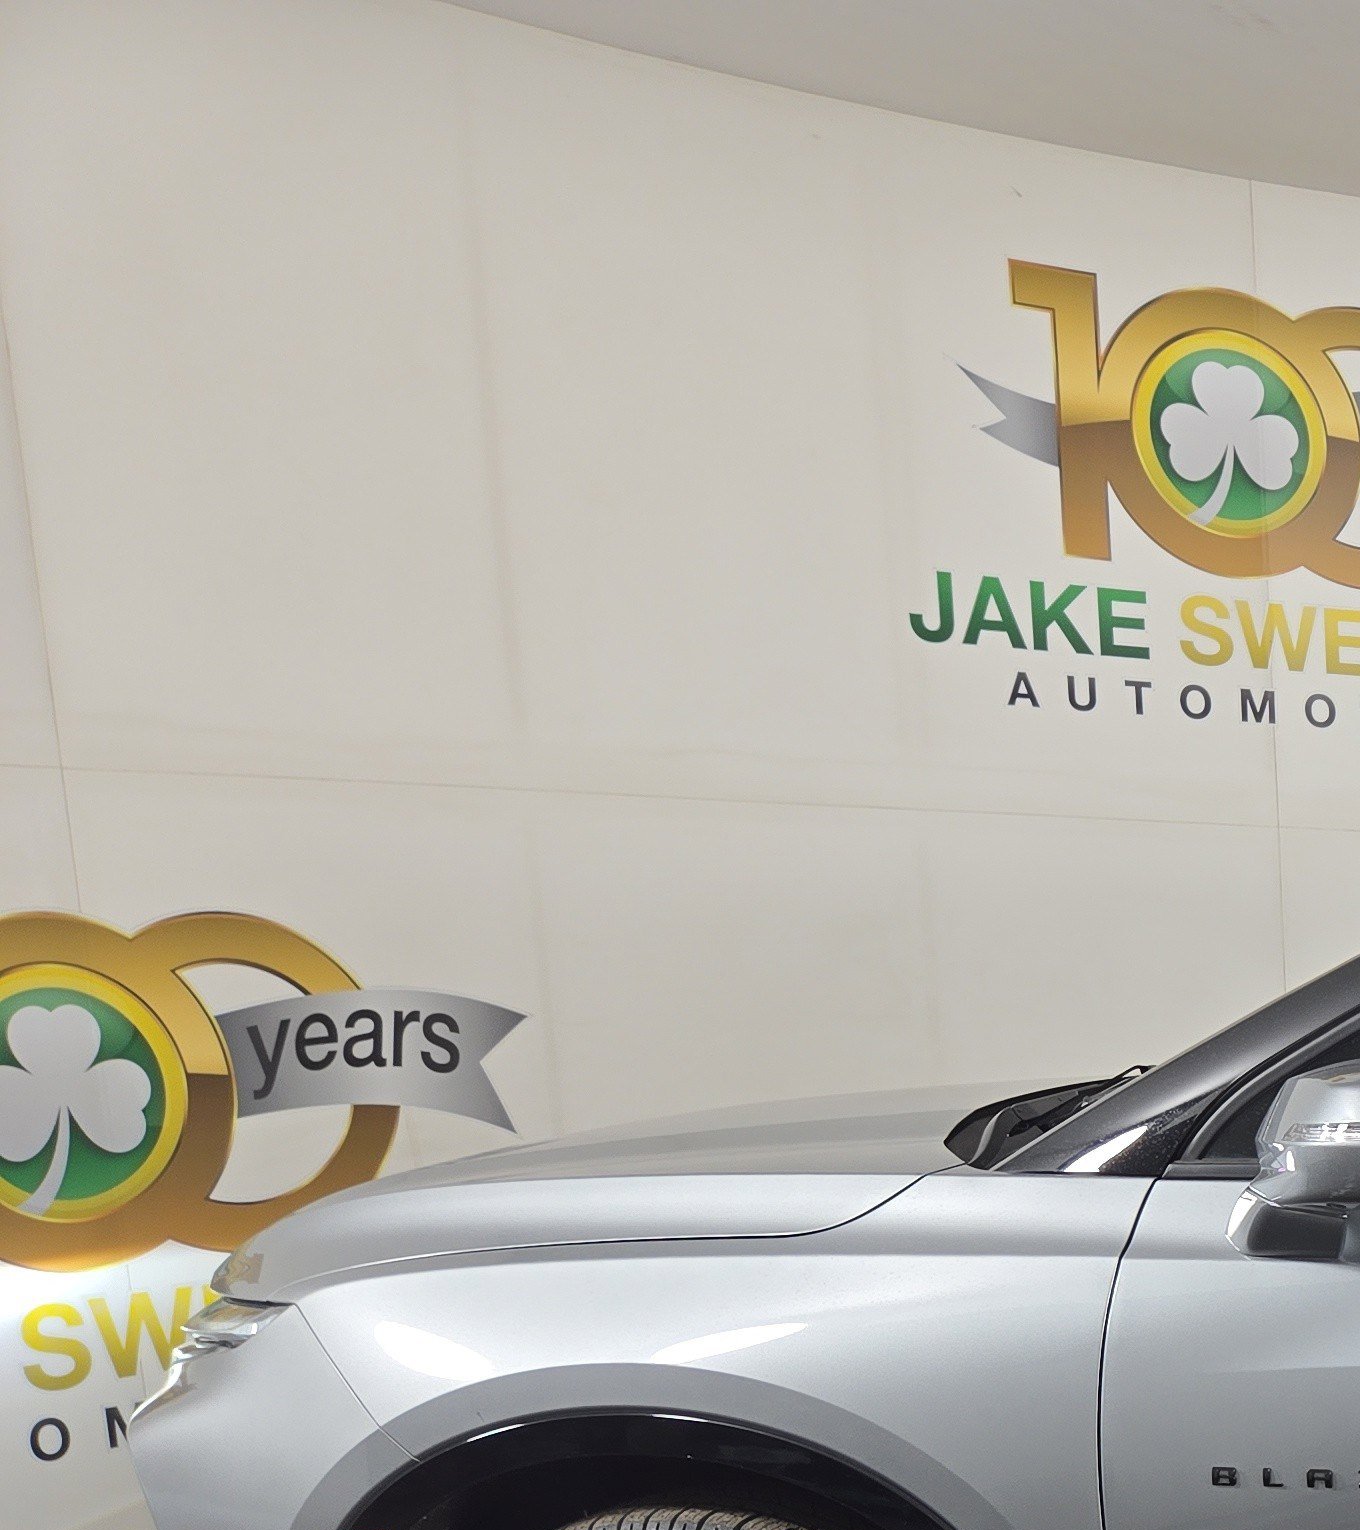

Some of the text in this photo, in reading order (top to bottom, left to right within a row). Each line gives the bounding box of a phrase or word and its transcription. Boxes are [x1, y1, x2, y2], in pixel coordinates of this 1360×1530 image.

[908, 569, 1151, 660] JAKE
[246, 1007, 461, 1101] years
[20, 1284, 224, 1391] SW
